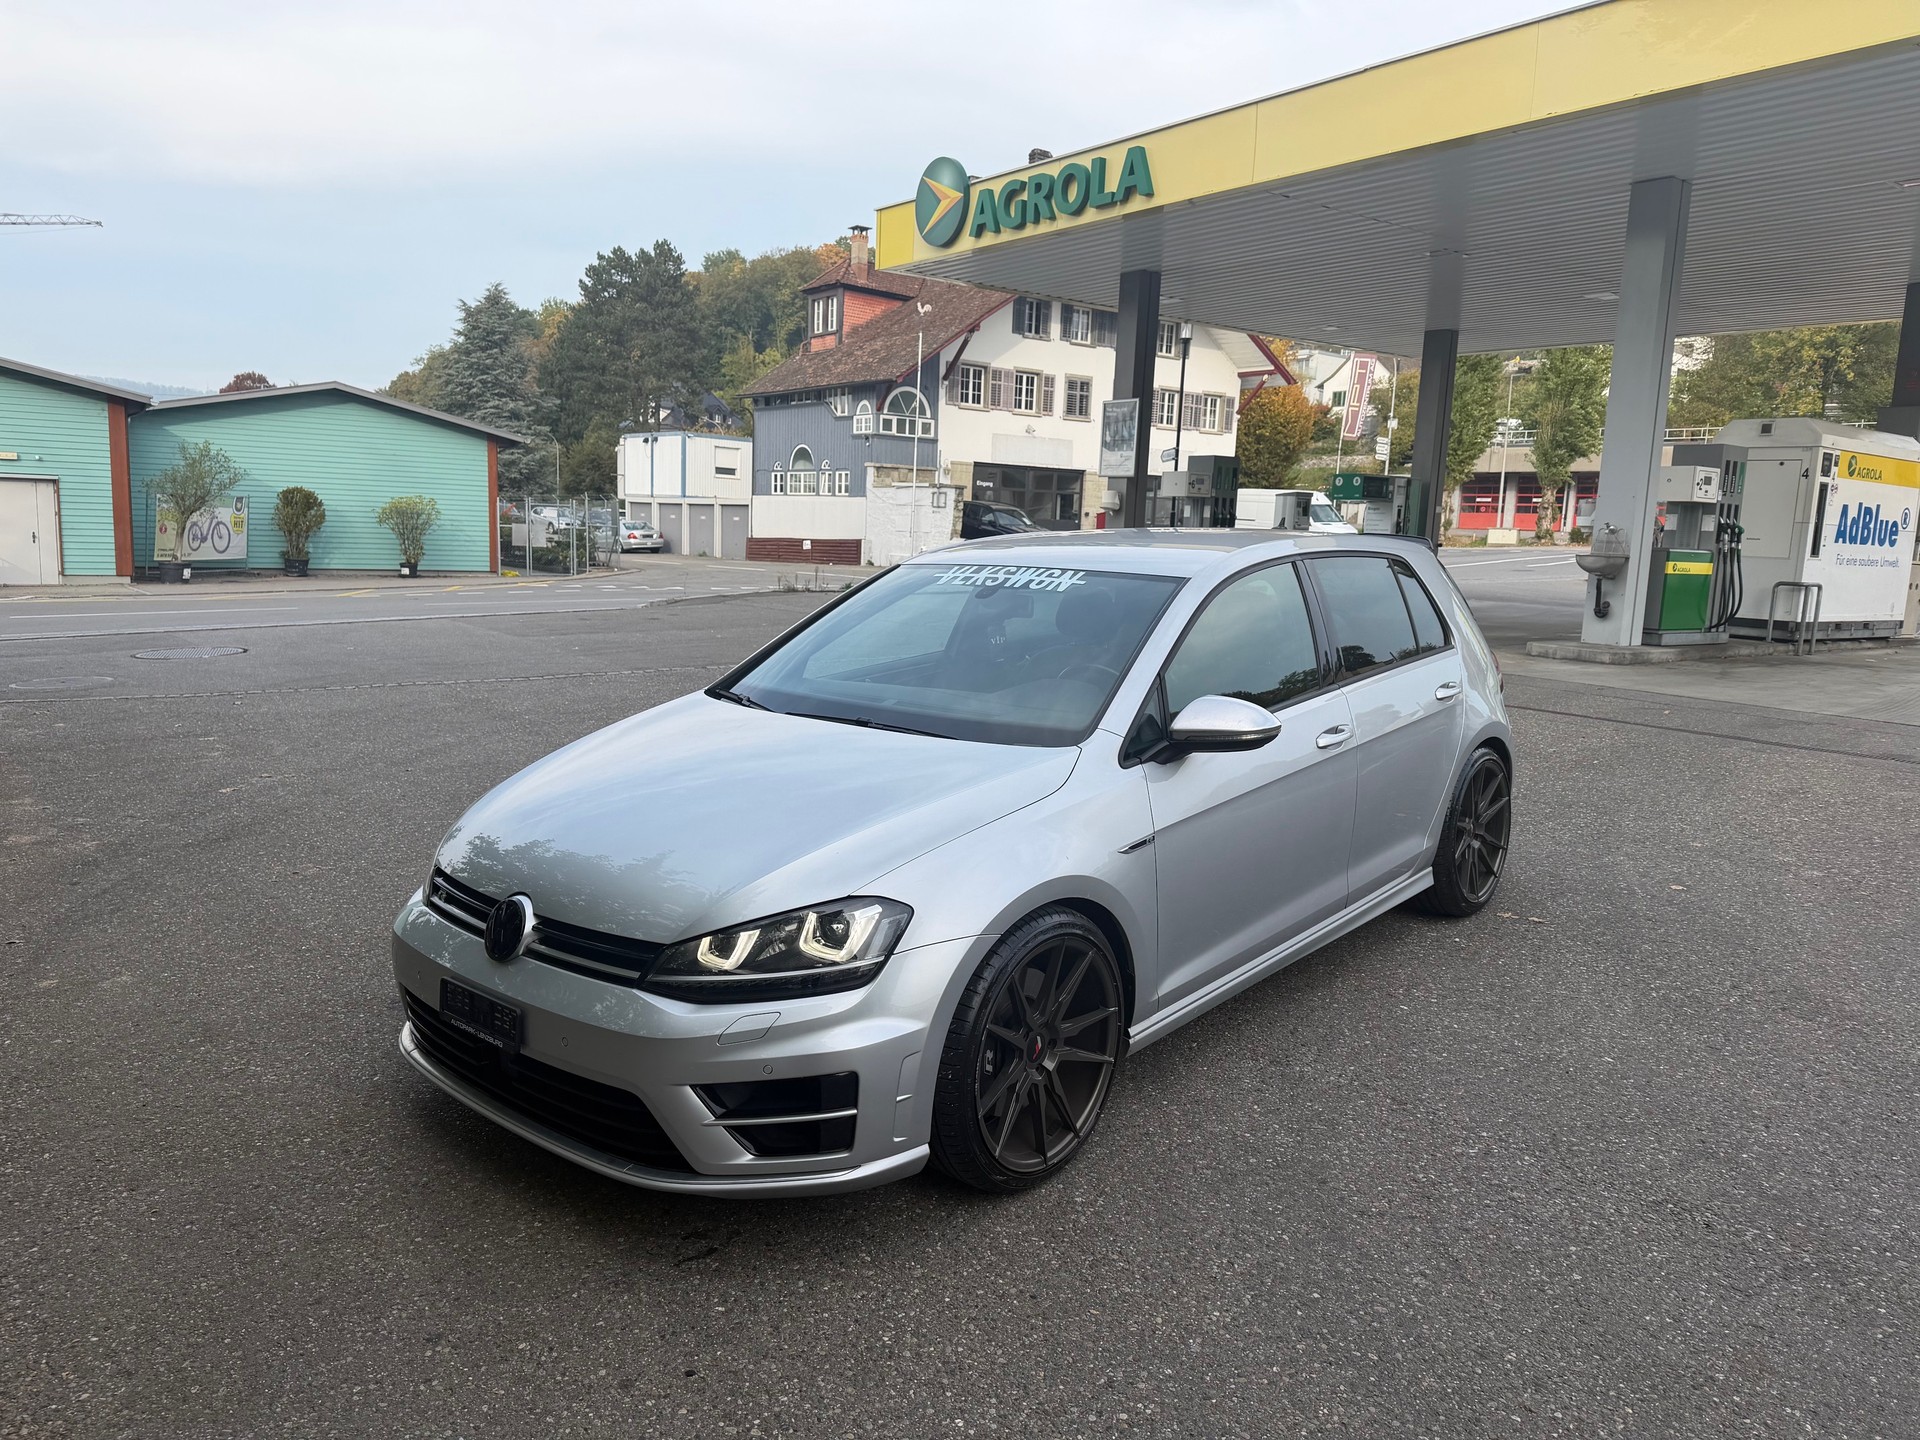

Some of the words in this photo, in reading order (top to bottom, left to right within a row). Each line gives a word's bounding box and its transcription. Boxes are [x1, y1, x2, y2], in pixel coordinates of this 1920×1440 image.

[969, 145, 1154, 238] AGROLA
[1802, 467, 1809, 479] 4
[1857, 467, 1882, 480] AGROLA
[1191, 480, 1196, 489] 6
[1699, 478, 1704, 490] 2
[233, 520, 244, 529] HIT
[1835, 553, 1845, 565] Für
[1846, 554, 1857, 566] eine
[1858, 555, 1879, 567] saubere
[935, 566, 1086, 592] VLKSWGN
[451, 1018, 503, 1047] AUTOPARK-LENZBURG
